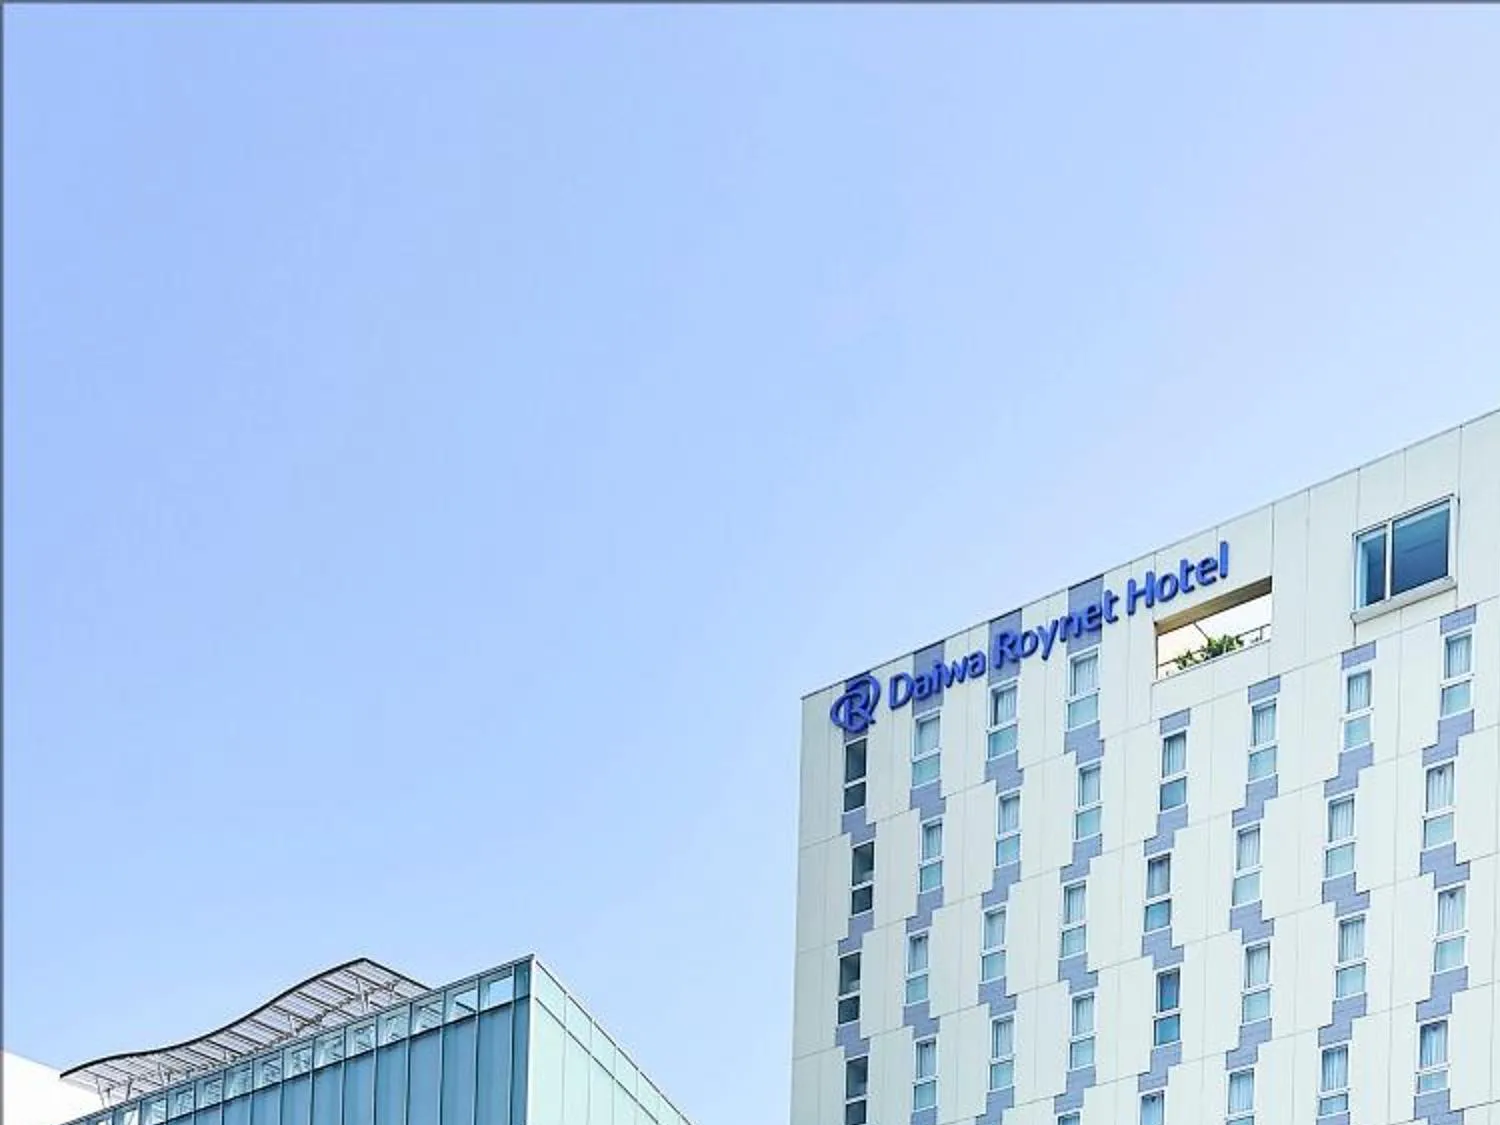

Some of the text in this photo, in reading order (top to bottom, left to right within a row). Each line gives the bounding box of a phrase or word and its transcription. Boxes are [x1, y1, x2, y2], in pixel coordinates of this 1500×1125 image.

[889, 650, 986, 709] Daiwa
[994, 589, 1119, 669] Roynet
[1127, 541, 1229, 616] Hotel
